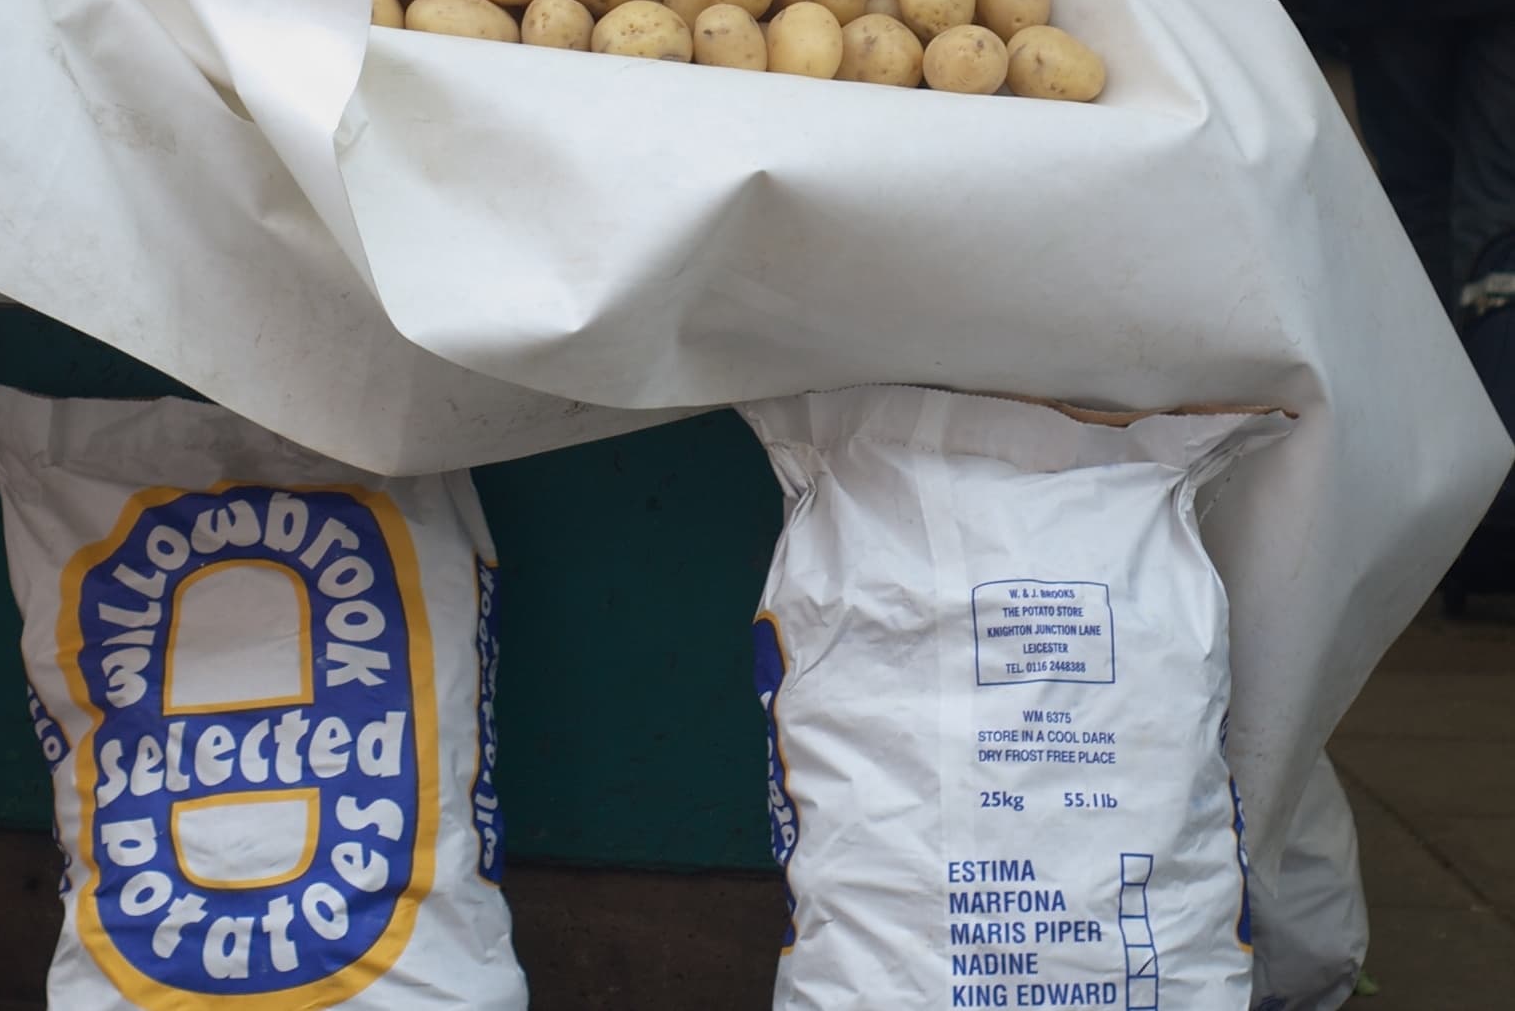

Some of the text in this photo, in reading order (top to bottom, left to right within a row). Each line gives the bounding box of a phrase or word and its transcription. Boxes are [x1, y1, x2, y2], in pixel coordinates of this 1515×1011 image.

[1003, 606, 1084, 618] THE POTATO STORE
[987, 625, 1102, 638] KNIGHTON JUNCTION LANE
[1023, 643, 1069, 654] LEICESTER
[1026, 661, 1047, 673] 0116
[1023, 710, 1072, 724] WM 6375
[978, 730, 1116, 744] STORE IN A COOL DARK
[978, 749, 1116, 764] DRY FROST FREE PLACE
[980, 791, 1025, 812] 25kg
[948, 859, 1036, 883] ESTIMA
[949, 890, 1067, 914] MARFONA
[950, 921, 1102, 945] MARIS PIPER
[952, 953, 1039, 976] NADINE
[953, 982, 1117, 1008] KING EDWARD
